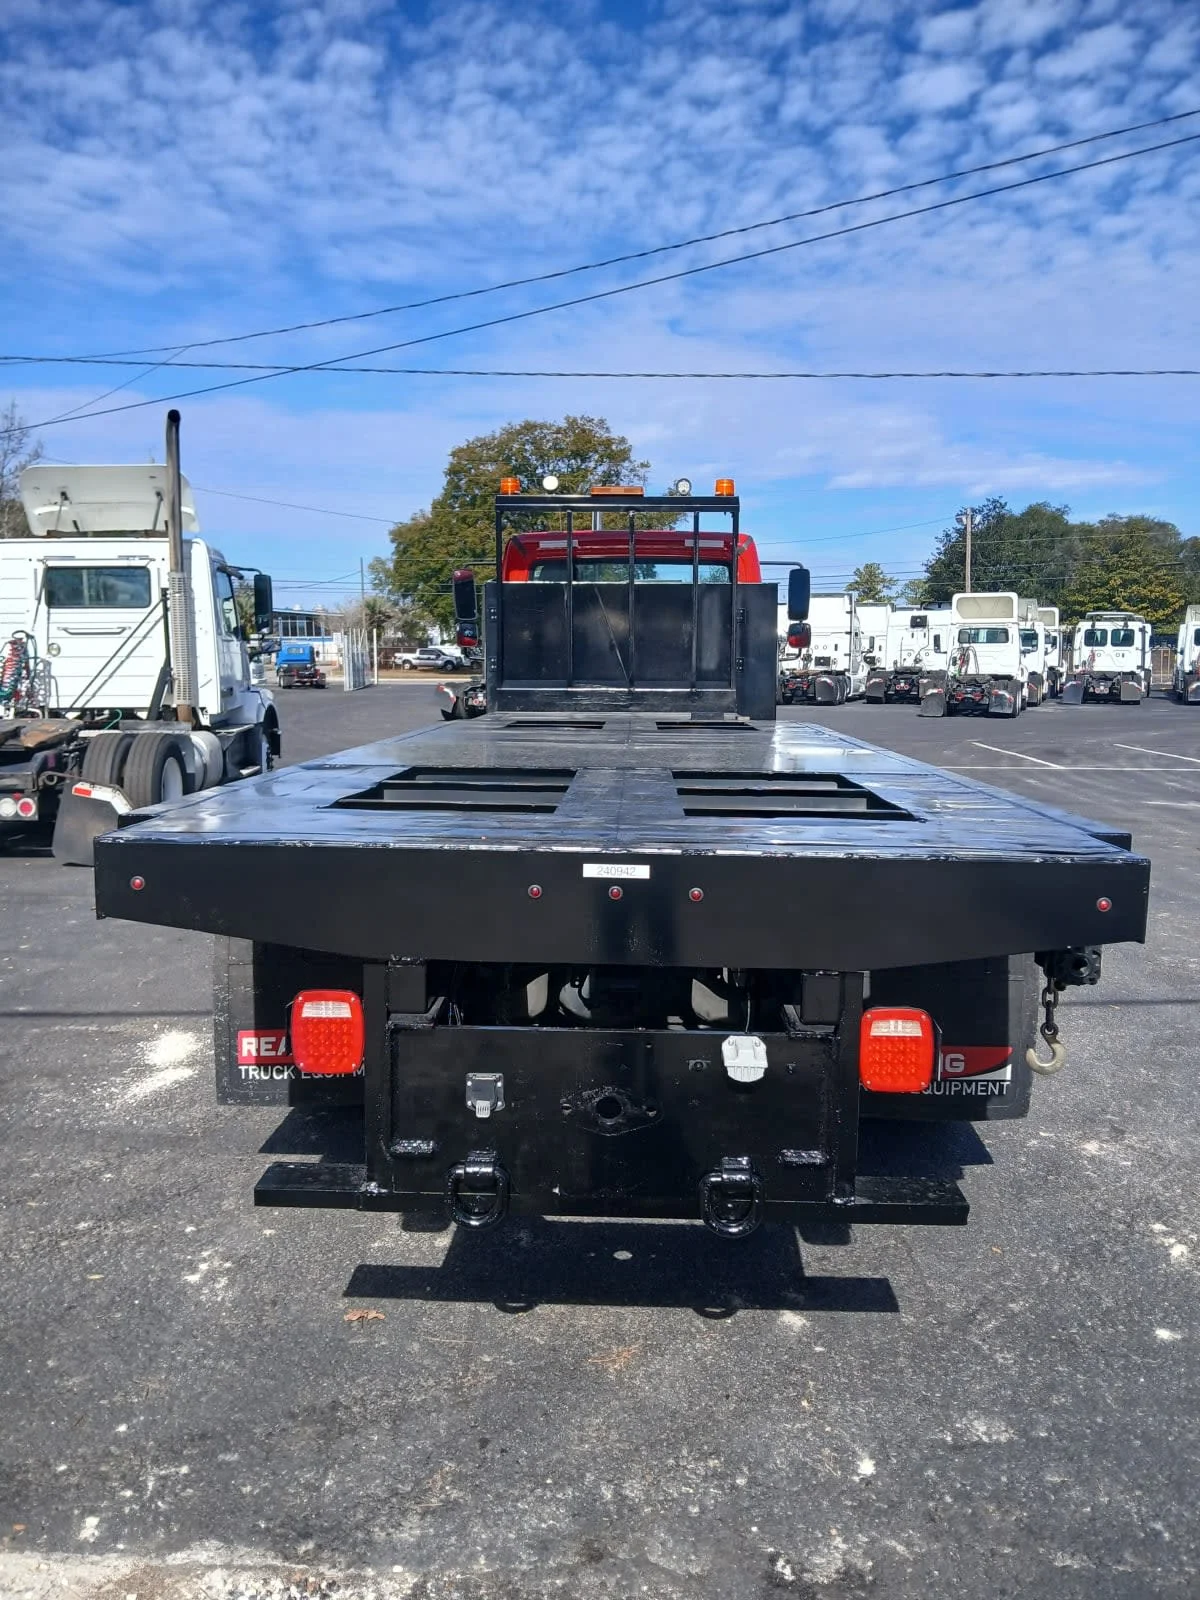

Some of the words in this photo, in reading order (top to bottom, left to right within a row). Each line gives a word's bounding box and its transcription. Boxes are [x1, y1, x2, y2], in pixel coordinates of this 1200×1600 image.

[597, 866, 636, 876] 240942
[238, 1065, 295, 1080] TRUCK
[911, 1081, 1011, 1096] QUIPMENT
